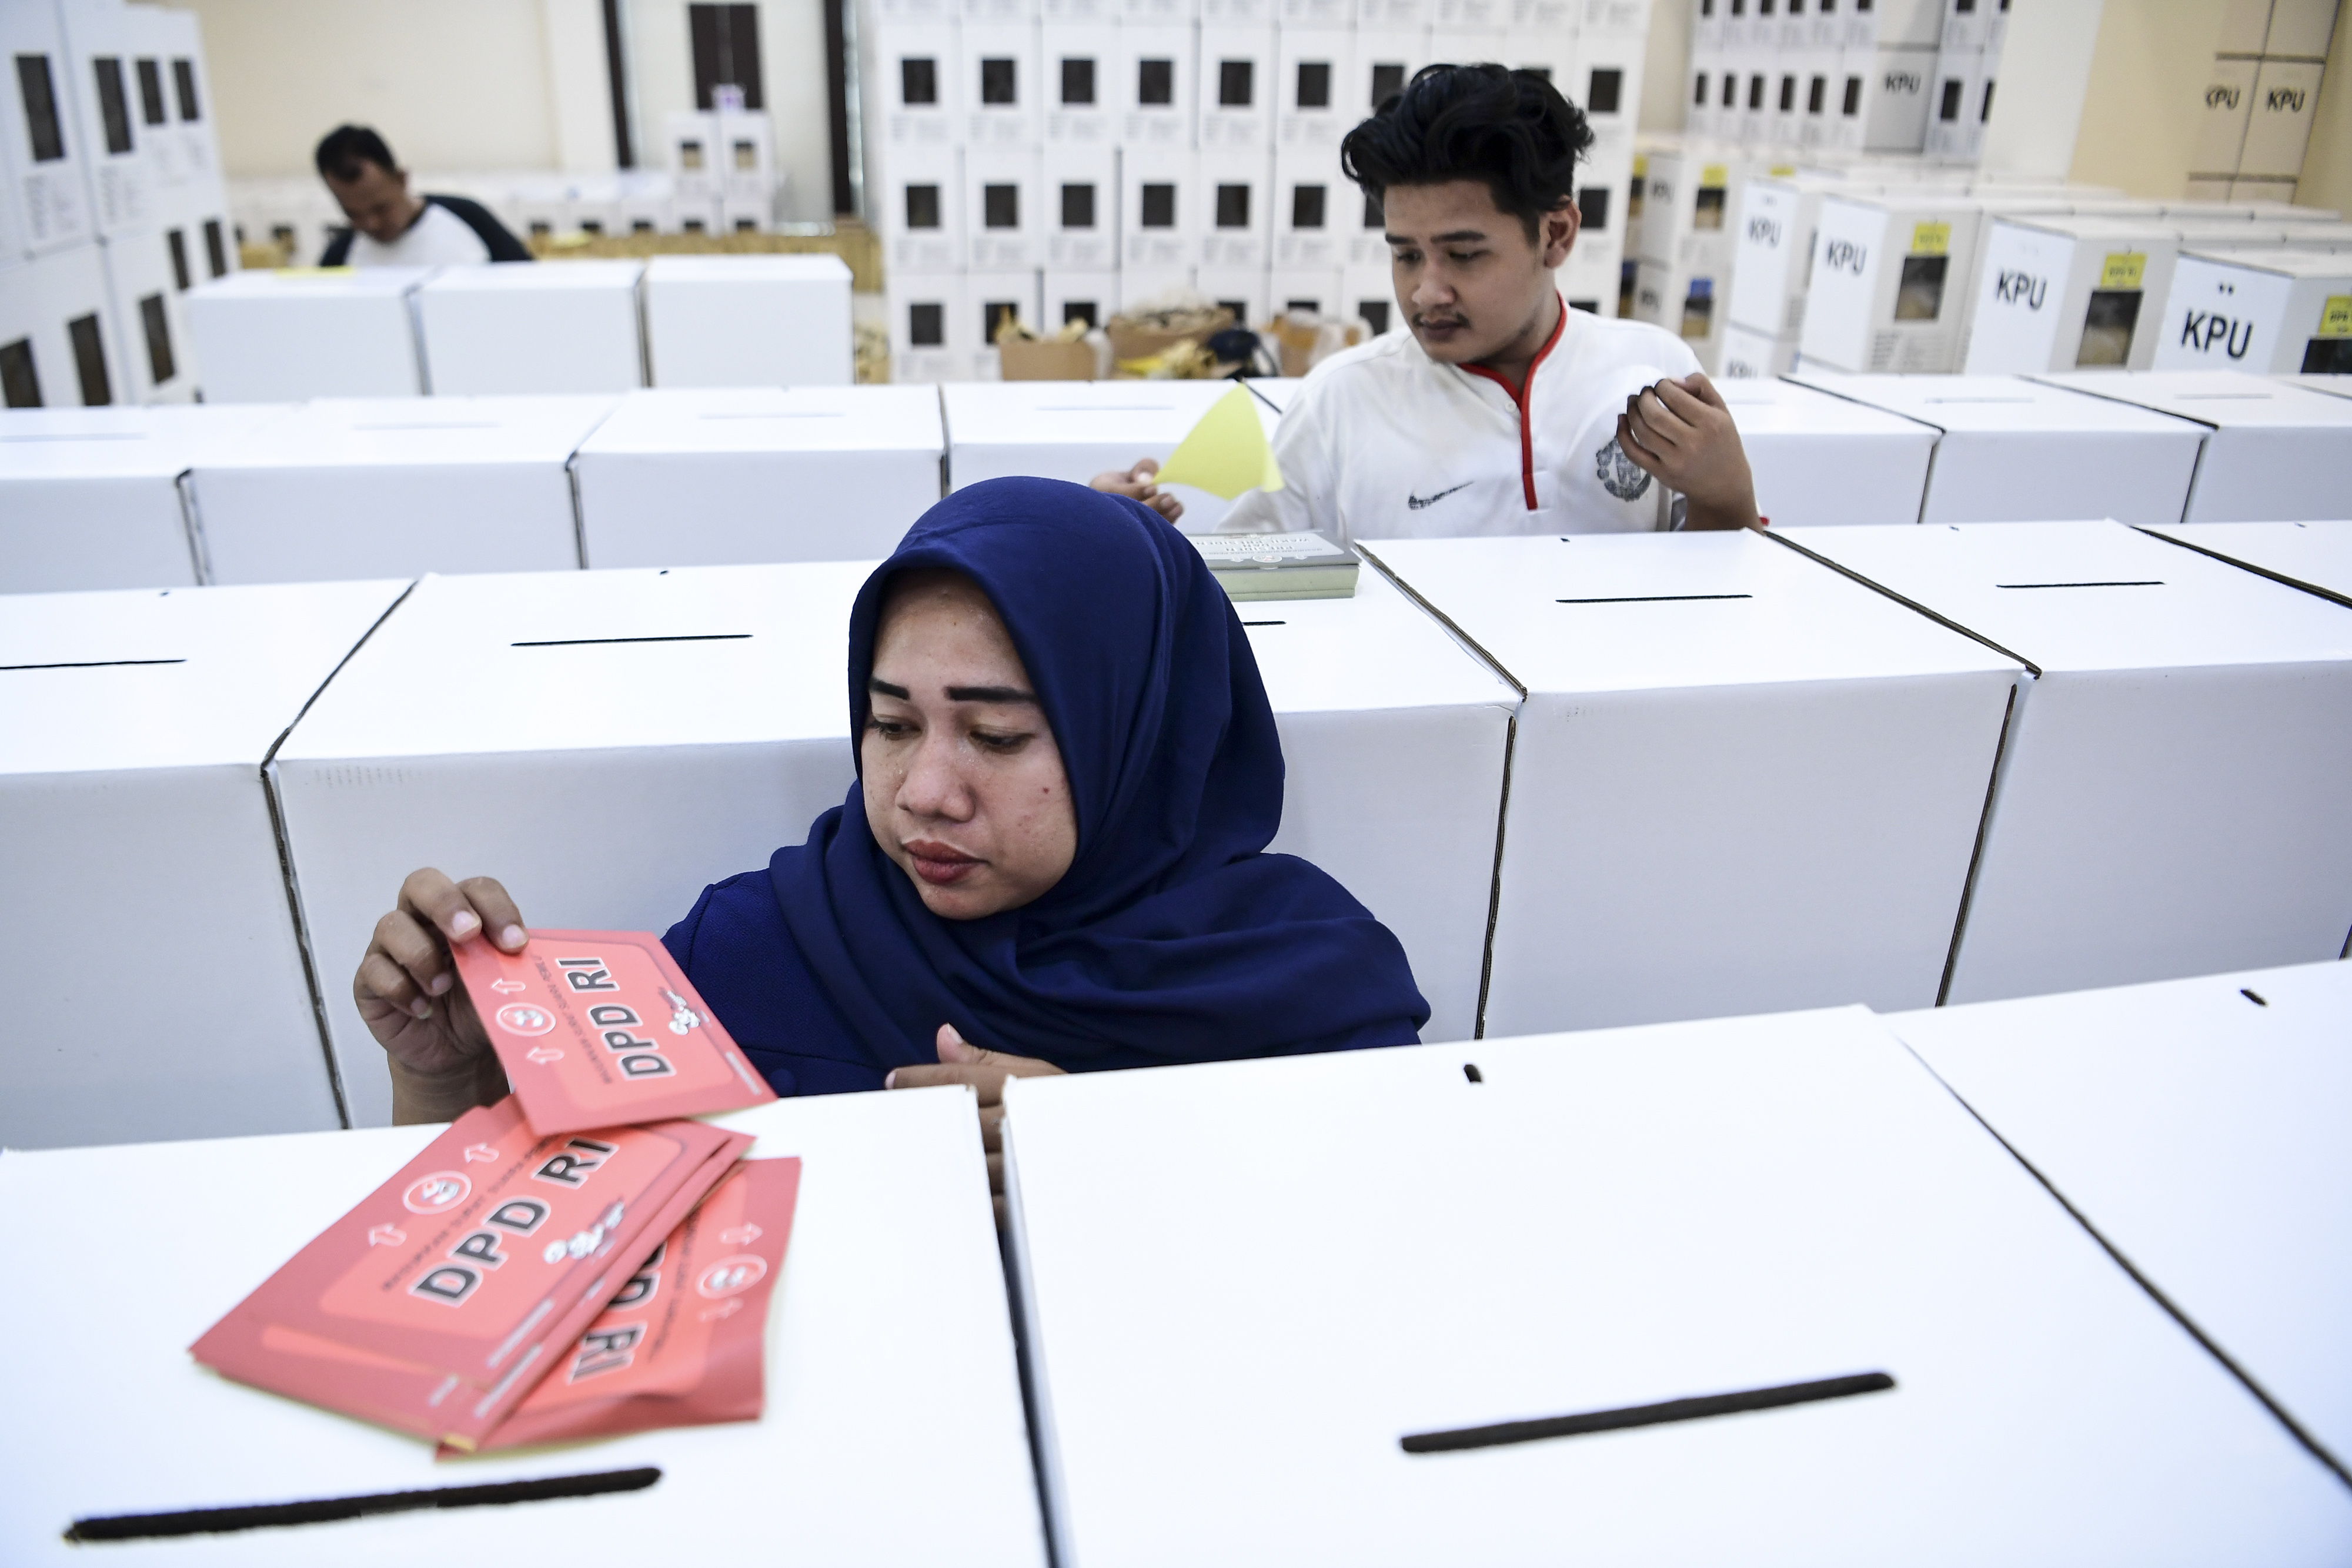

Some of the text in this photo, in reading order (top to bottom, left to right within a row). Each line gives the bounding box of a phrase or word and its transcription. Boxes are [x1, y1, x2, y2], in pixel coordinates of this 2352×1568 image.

[1885, 71, 1921, 96] KPU
[2267, 89, 2305, 112] KPU
[1749, 216, 1782, 248] KPU
[1828, 240, 1867, 276] KPU
[1997, 270, 2047, 310] KPU
[2181, 309, 2253, 360] KPU
[556, 958, 676, 1080] DPD RI
[410, 1196, 550, 1306] DPD
[531, 1136, 619, 1189] RI
